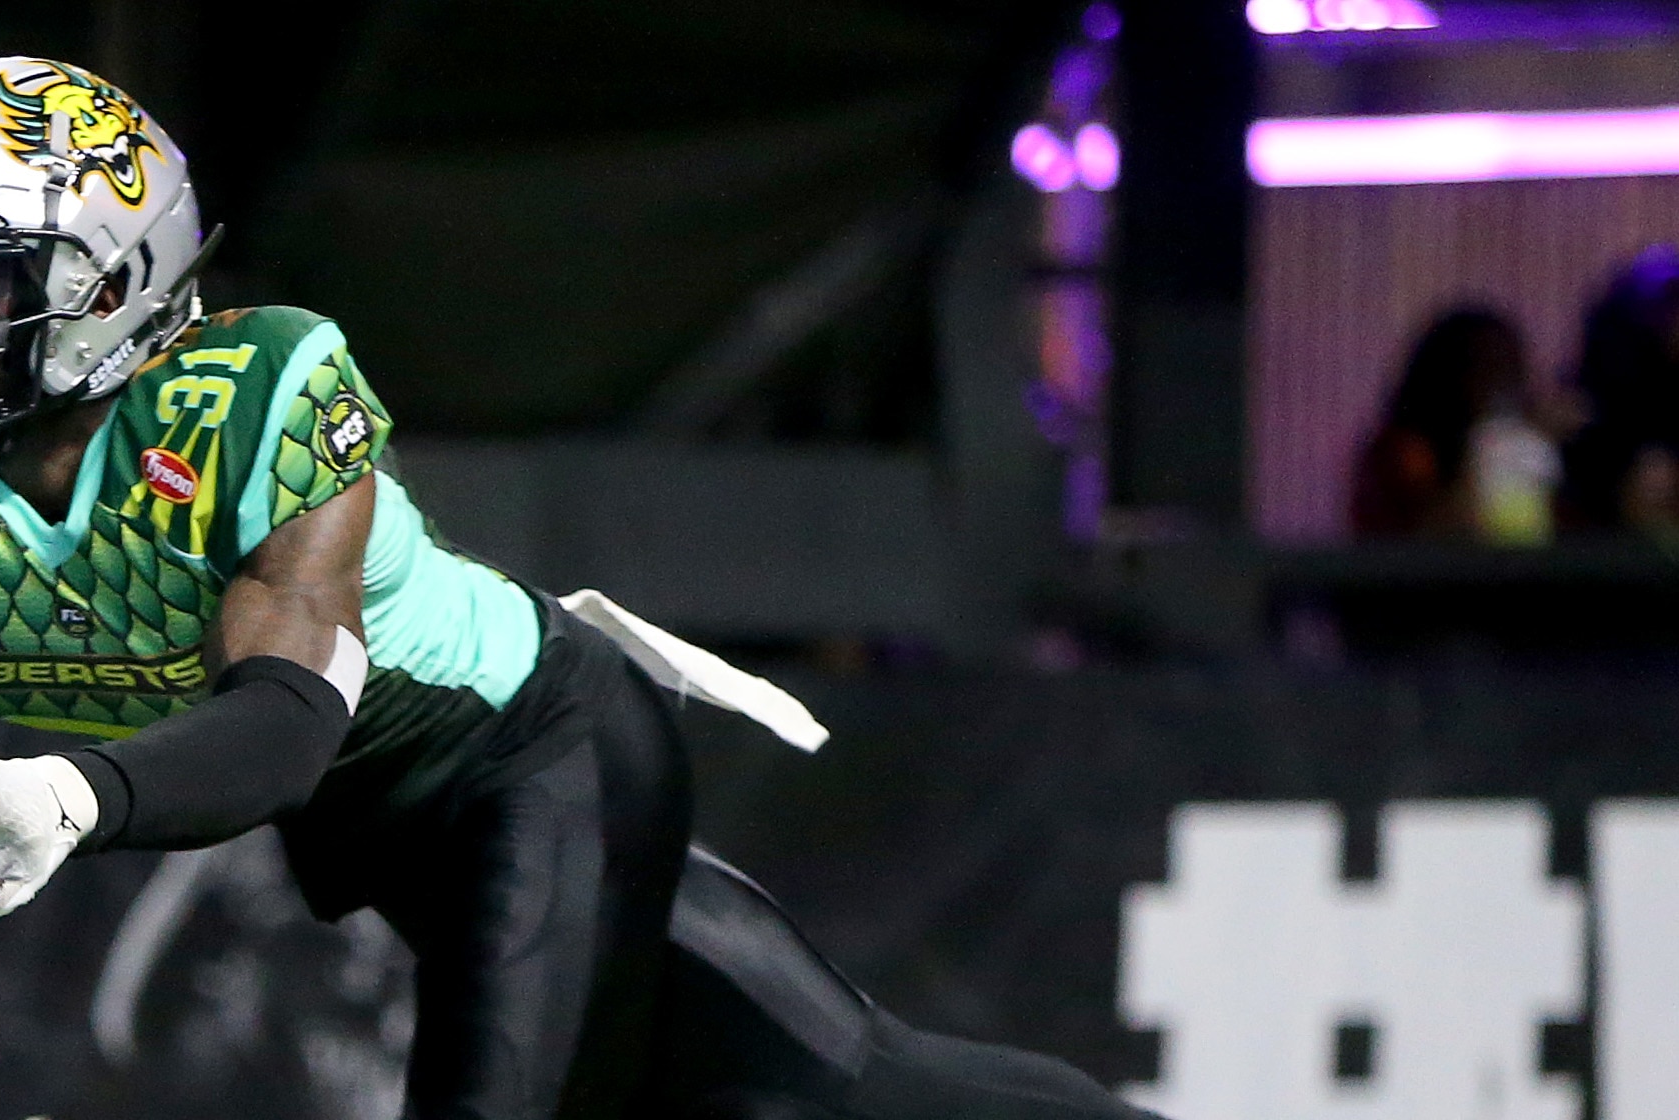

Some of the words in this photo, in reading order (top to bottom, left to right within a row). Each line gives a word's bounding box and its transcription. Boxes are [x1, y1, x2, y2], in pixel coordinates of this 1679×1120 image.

[156, 343, 258, 428] 31
[331, 410, 367, 455] FCF
[146, 451, 195, 497] Tyson
[60, 608, 87, 622] FC
